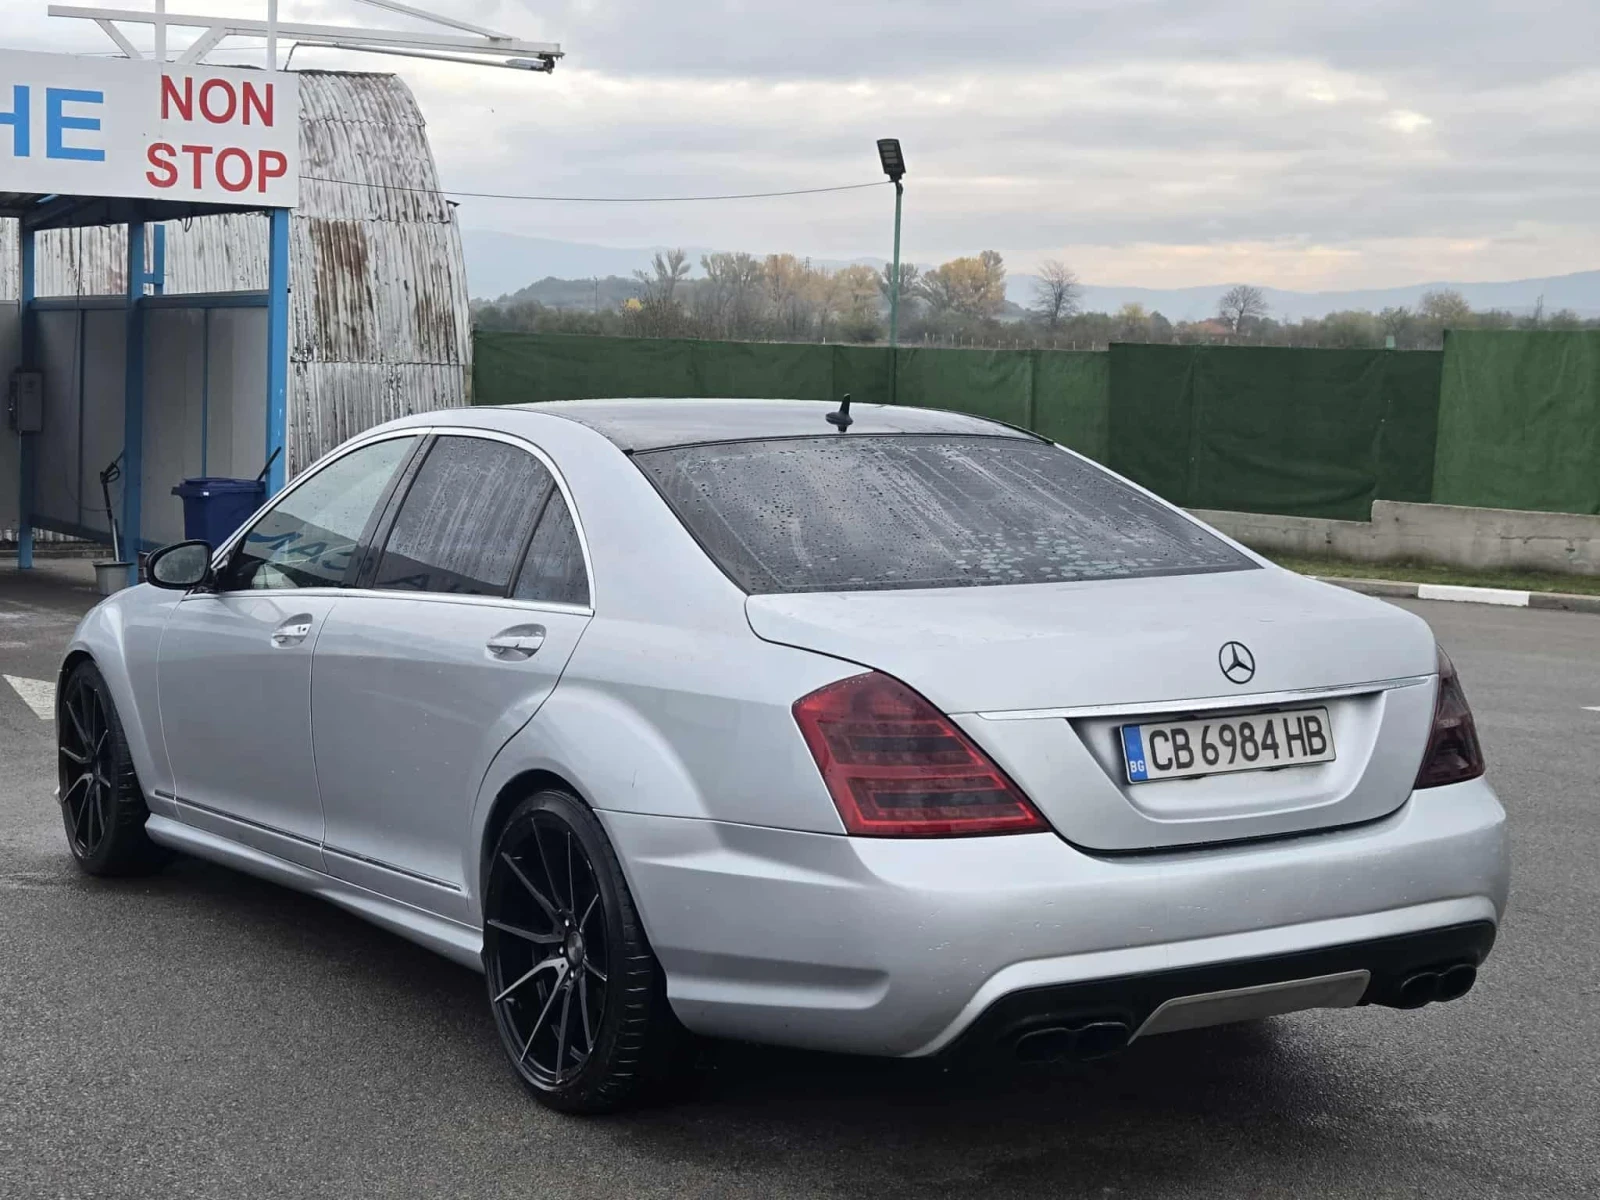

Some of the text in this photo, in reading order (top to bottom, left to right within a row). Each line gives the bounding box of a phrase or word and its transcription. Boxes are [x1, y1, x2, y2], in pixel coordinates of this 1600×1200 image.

[161, 74, 274, 127] NON
[145, 142, 288, 193] STOP
[1129, 760, 1145, 774] BG
[1149, 715, 1327, 771] CB 6984 HB
